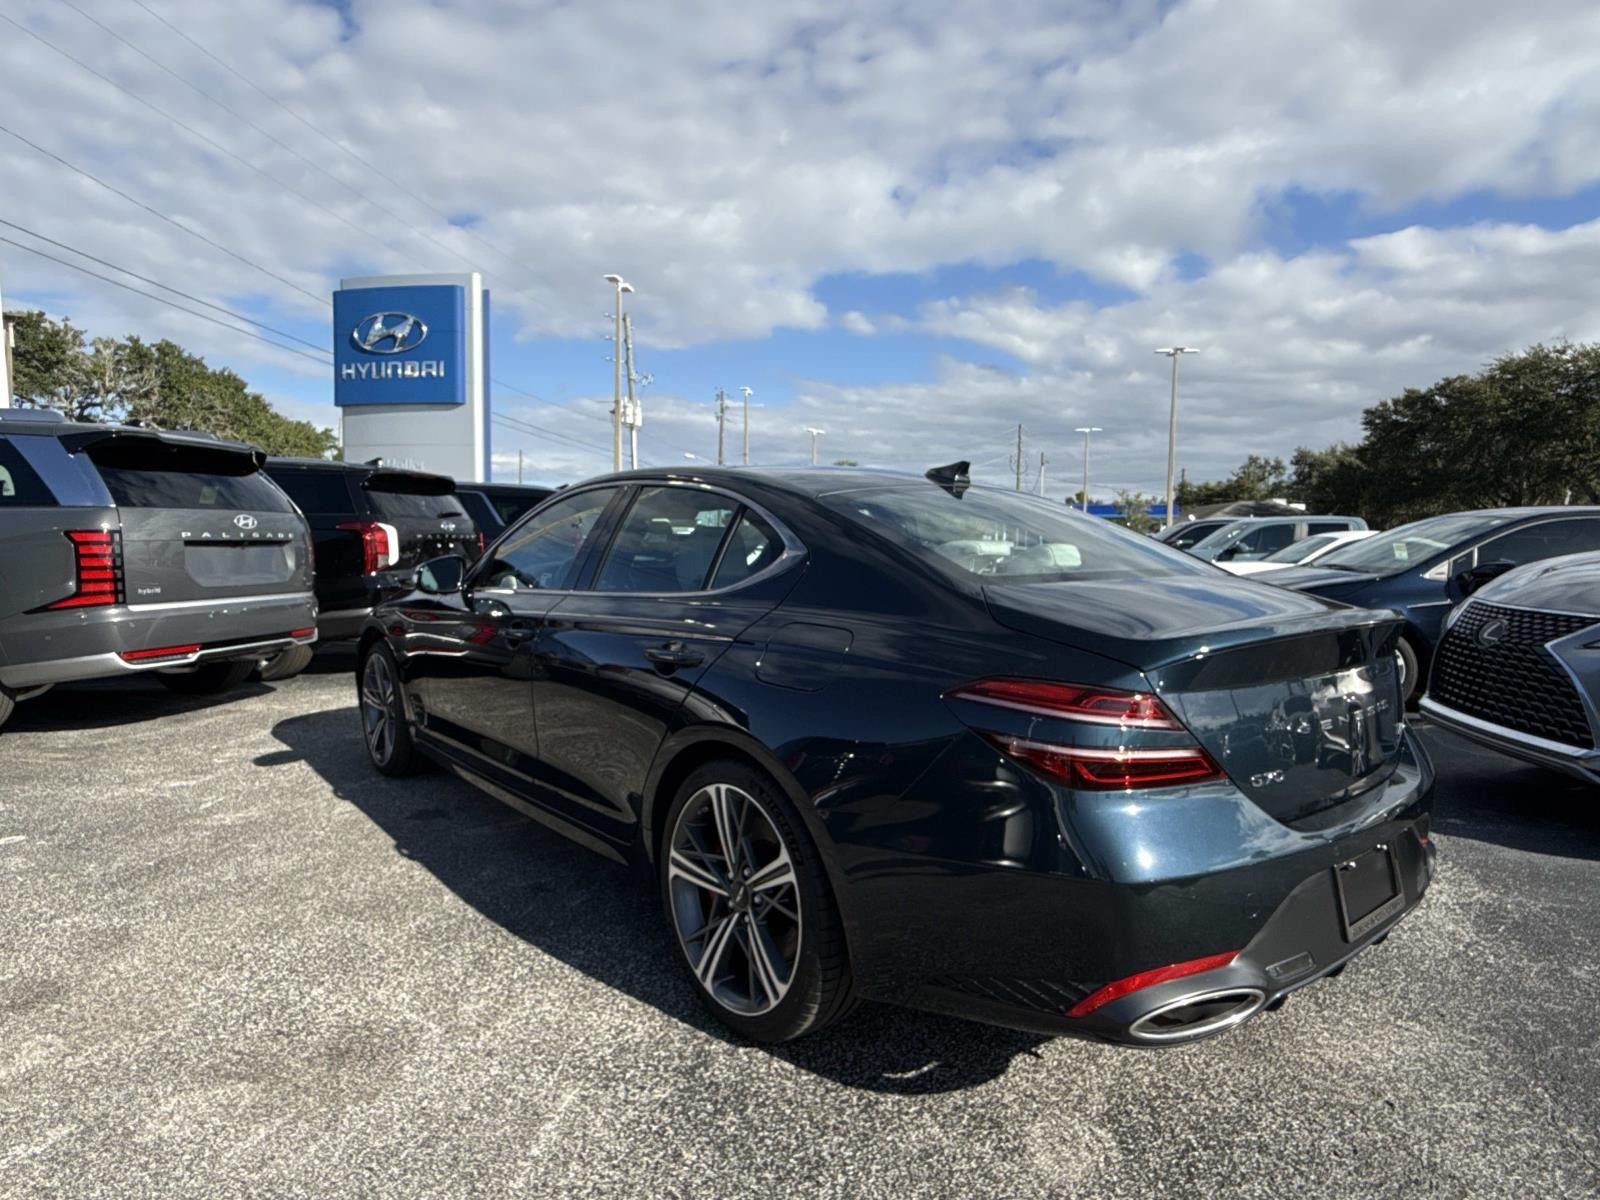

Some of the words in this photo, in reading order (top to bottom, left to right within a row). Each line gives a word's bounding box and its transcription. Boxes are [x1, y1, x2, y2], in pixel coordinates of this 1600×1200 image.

[342, 360, 445, 380] HYUNDAI
[181, 531, 294, 539] PALISADE
[1250, 769, 1285, 788] G70
